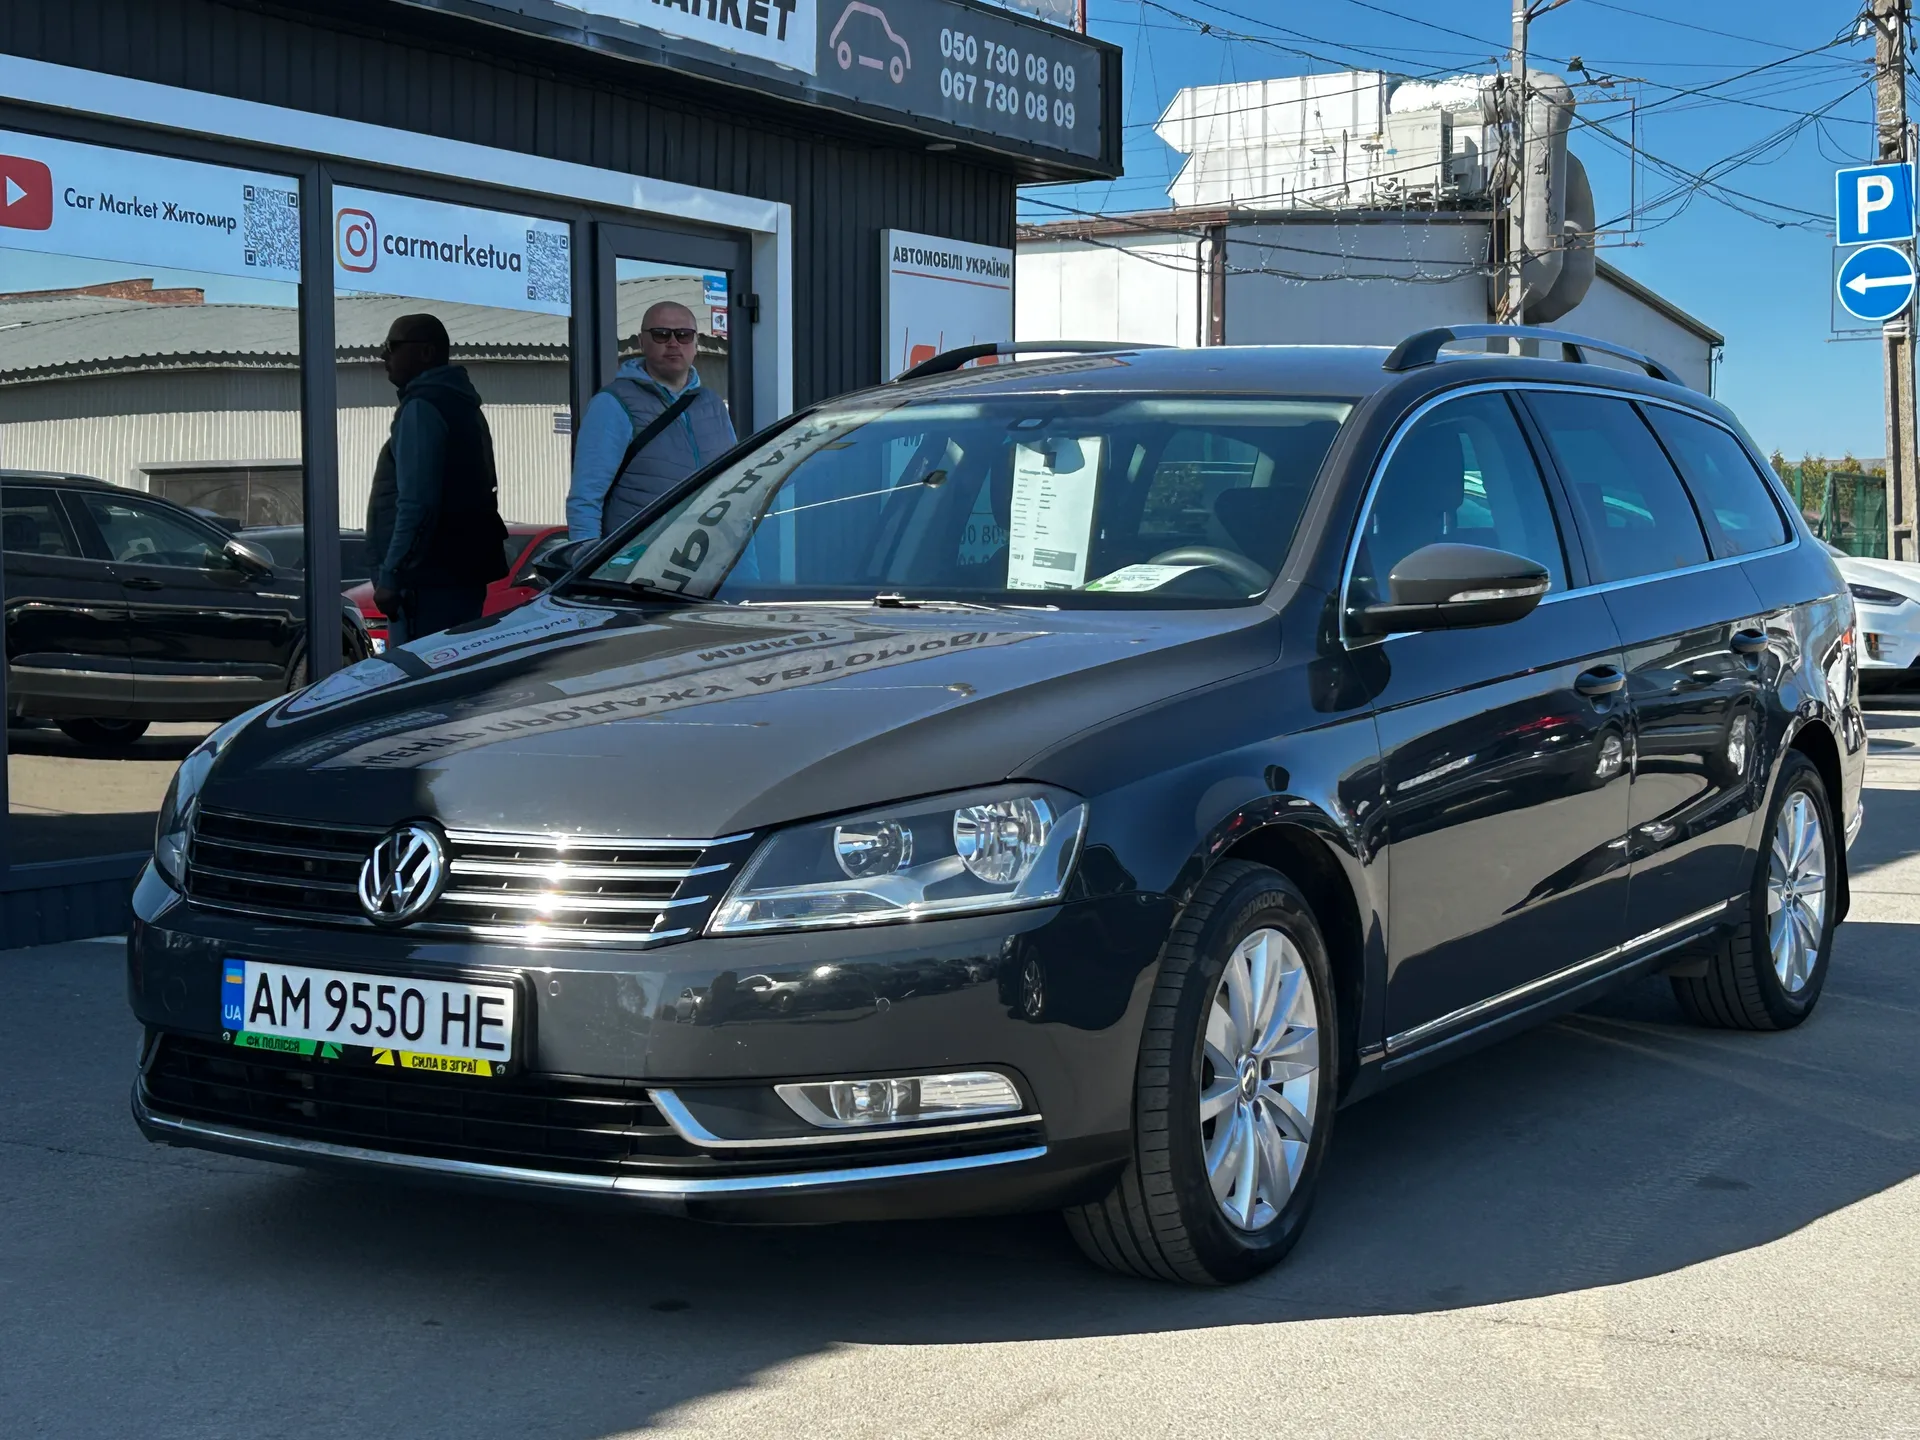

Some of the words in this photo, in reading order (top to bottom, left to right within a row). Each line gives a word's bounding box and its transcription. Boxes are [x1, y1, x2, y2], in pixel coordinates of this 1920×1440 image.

[940, 28, 977, 65] 050
[984, 40, 1019, 77] 730
[1025, 53, 1048, 85] 08
[1053, 61, 1075, 93] 09
[940, 67, 977, 104] 067
[984, 79, 1019, 115] 730
[1025, 91, 1048, 122] 08
[1053, 99, 1075, 129] 09
[64, 187, 95, 210] Car
[99, 192, 158, 219] Market
[162, 201, 237, 235] Житомир
[1857, 175, 1894, 234] P
[383, 234, 521, 272] carmarketua
[893, 246, 962, 271] АВТОМОБІЛІ
[965, 256, 1010, 279] УКРАЇНИ
[225, 1005, 242, 1021] UA
[249, 972, 310, 1029] AM
[325, 980, 424, 1041] 9550
[441, 991, 505, 1051] HE
[412, 1055, 438, 1069] СИЛА
[441, 1059, 448, 1071] В
